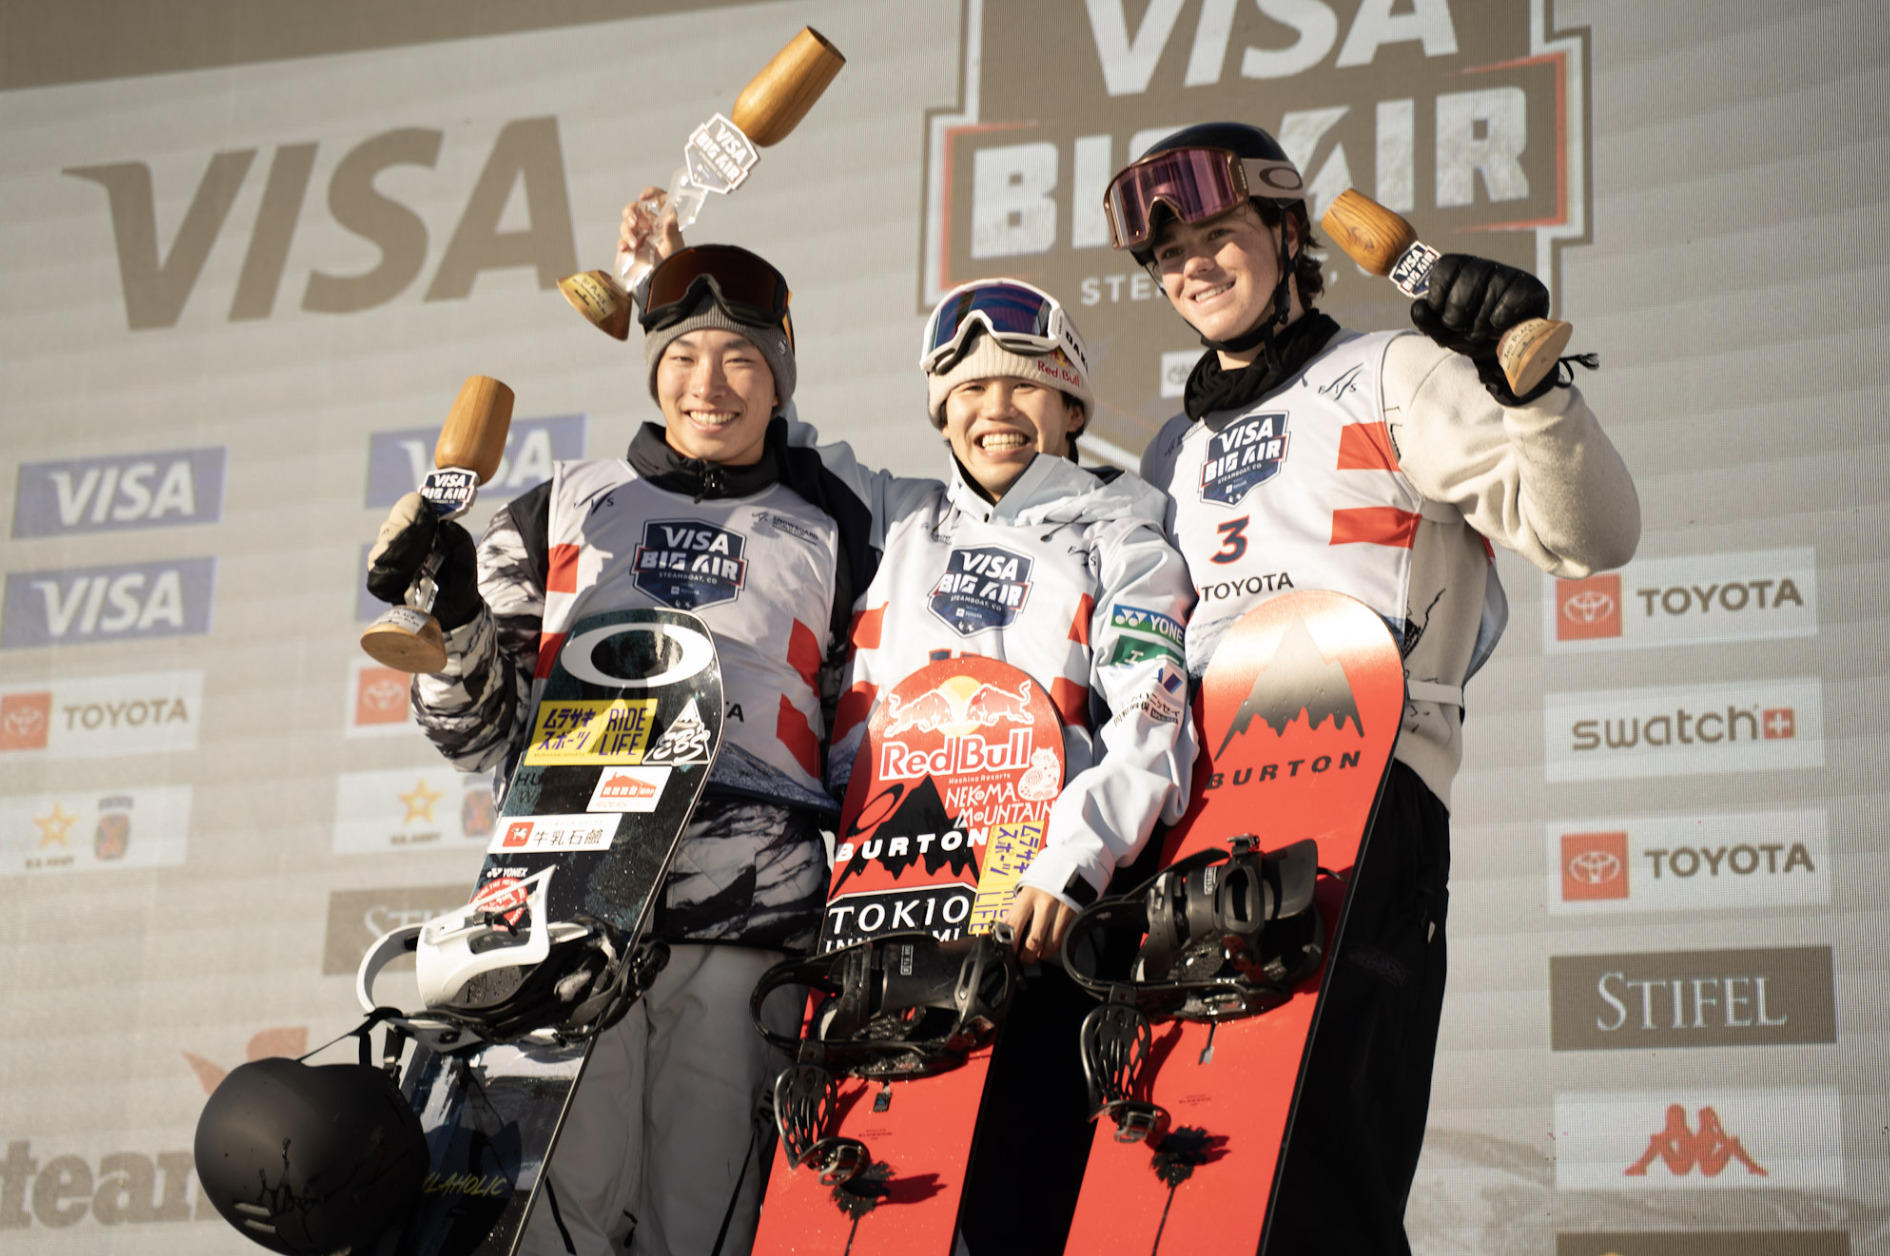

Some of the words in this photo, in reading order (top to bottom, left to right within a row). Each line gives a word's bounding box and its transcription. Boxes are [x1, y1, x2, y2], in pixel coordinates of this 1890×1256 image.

[716, 123, 747, 164] VISA
[61, 115, 579, 331] VISA
[1396, 250, 1423, 276] VISA
[1037, 360, 1058, 378] Red
[1062, 370, 1080, 387] Bull
[1218, 417, 1273, 453] VISA
[1205, 451, 1239, 483] BIG
[1242, 439, 1281, 466] AIR
[49, 460, 195, 527] VISA
[434, 474, 467, 488] VISA
[660, 526, 729, 556] VISA
[1210, 515, 1249, 564] 3
[640, 551, 687, 571] BIG
[691, 554, 738, 581] AIR
[960, 551, 1018, 581] VISA
[938, 573, 978, 594] BIG
[979, 581, 1022, 606] AIR
[1202, 572, 1294, 601] TOYOTA
[1636, 579, 1804, 617] TOYOTA
[32, 571, 184, 636] VISA
[63, 697, 189, 731] TOYOTA
[543, 707, 597, 729] ムラサキ
[606, 707, 648, 732] RIDE
[1572, 706, 1758, 751] swatch
[538, 731, 591, 750] スポーツ
[598, 734, 642, 756] LIFE
[879, 735, 954, 781] Red
[956, 728, 1033, 774] Bull
[949, 777, 979, 785] Hoshino
[981, 772, 1011, 782] Resorts
[1205, 751, 1361, 790] BURTON
[945, 782, 1017, 809] NEKOMA
[953, 800, 1055, 828] MOUNTAIN
[835, 827, 988, 862] BURTON
[1644, 842, 1815, 879] TOYOTA
[502, 867, 529, 878] YONEX
[829, 895, 970, 935] TOKIO
[1597, 971, 1787, 1031] STIFEL
